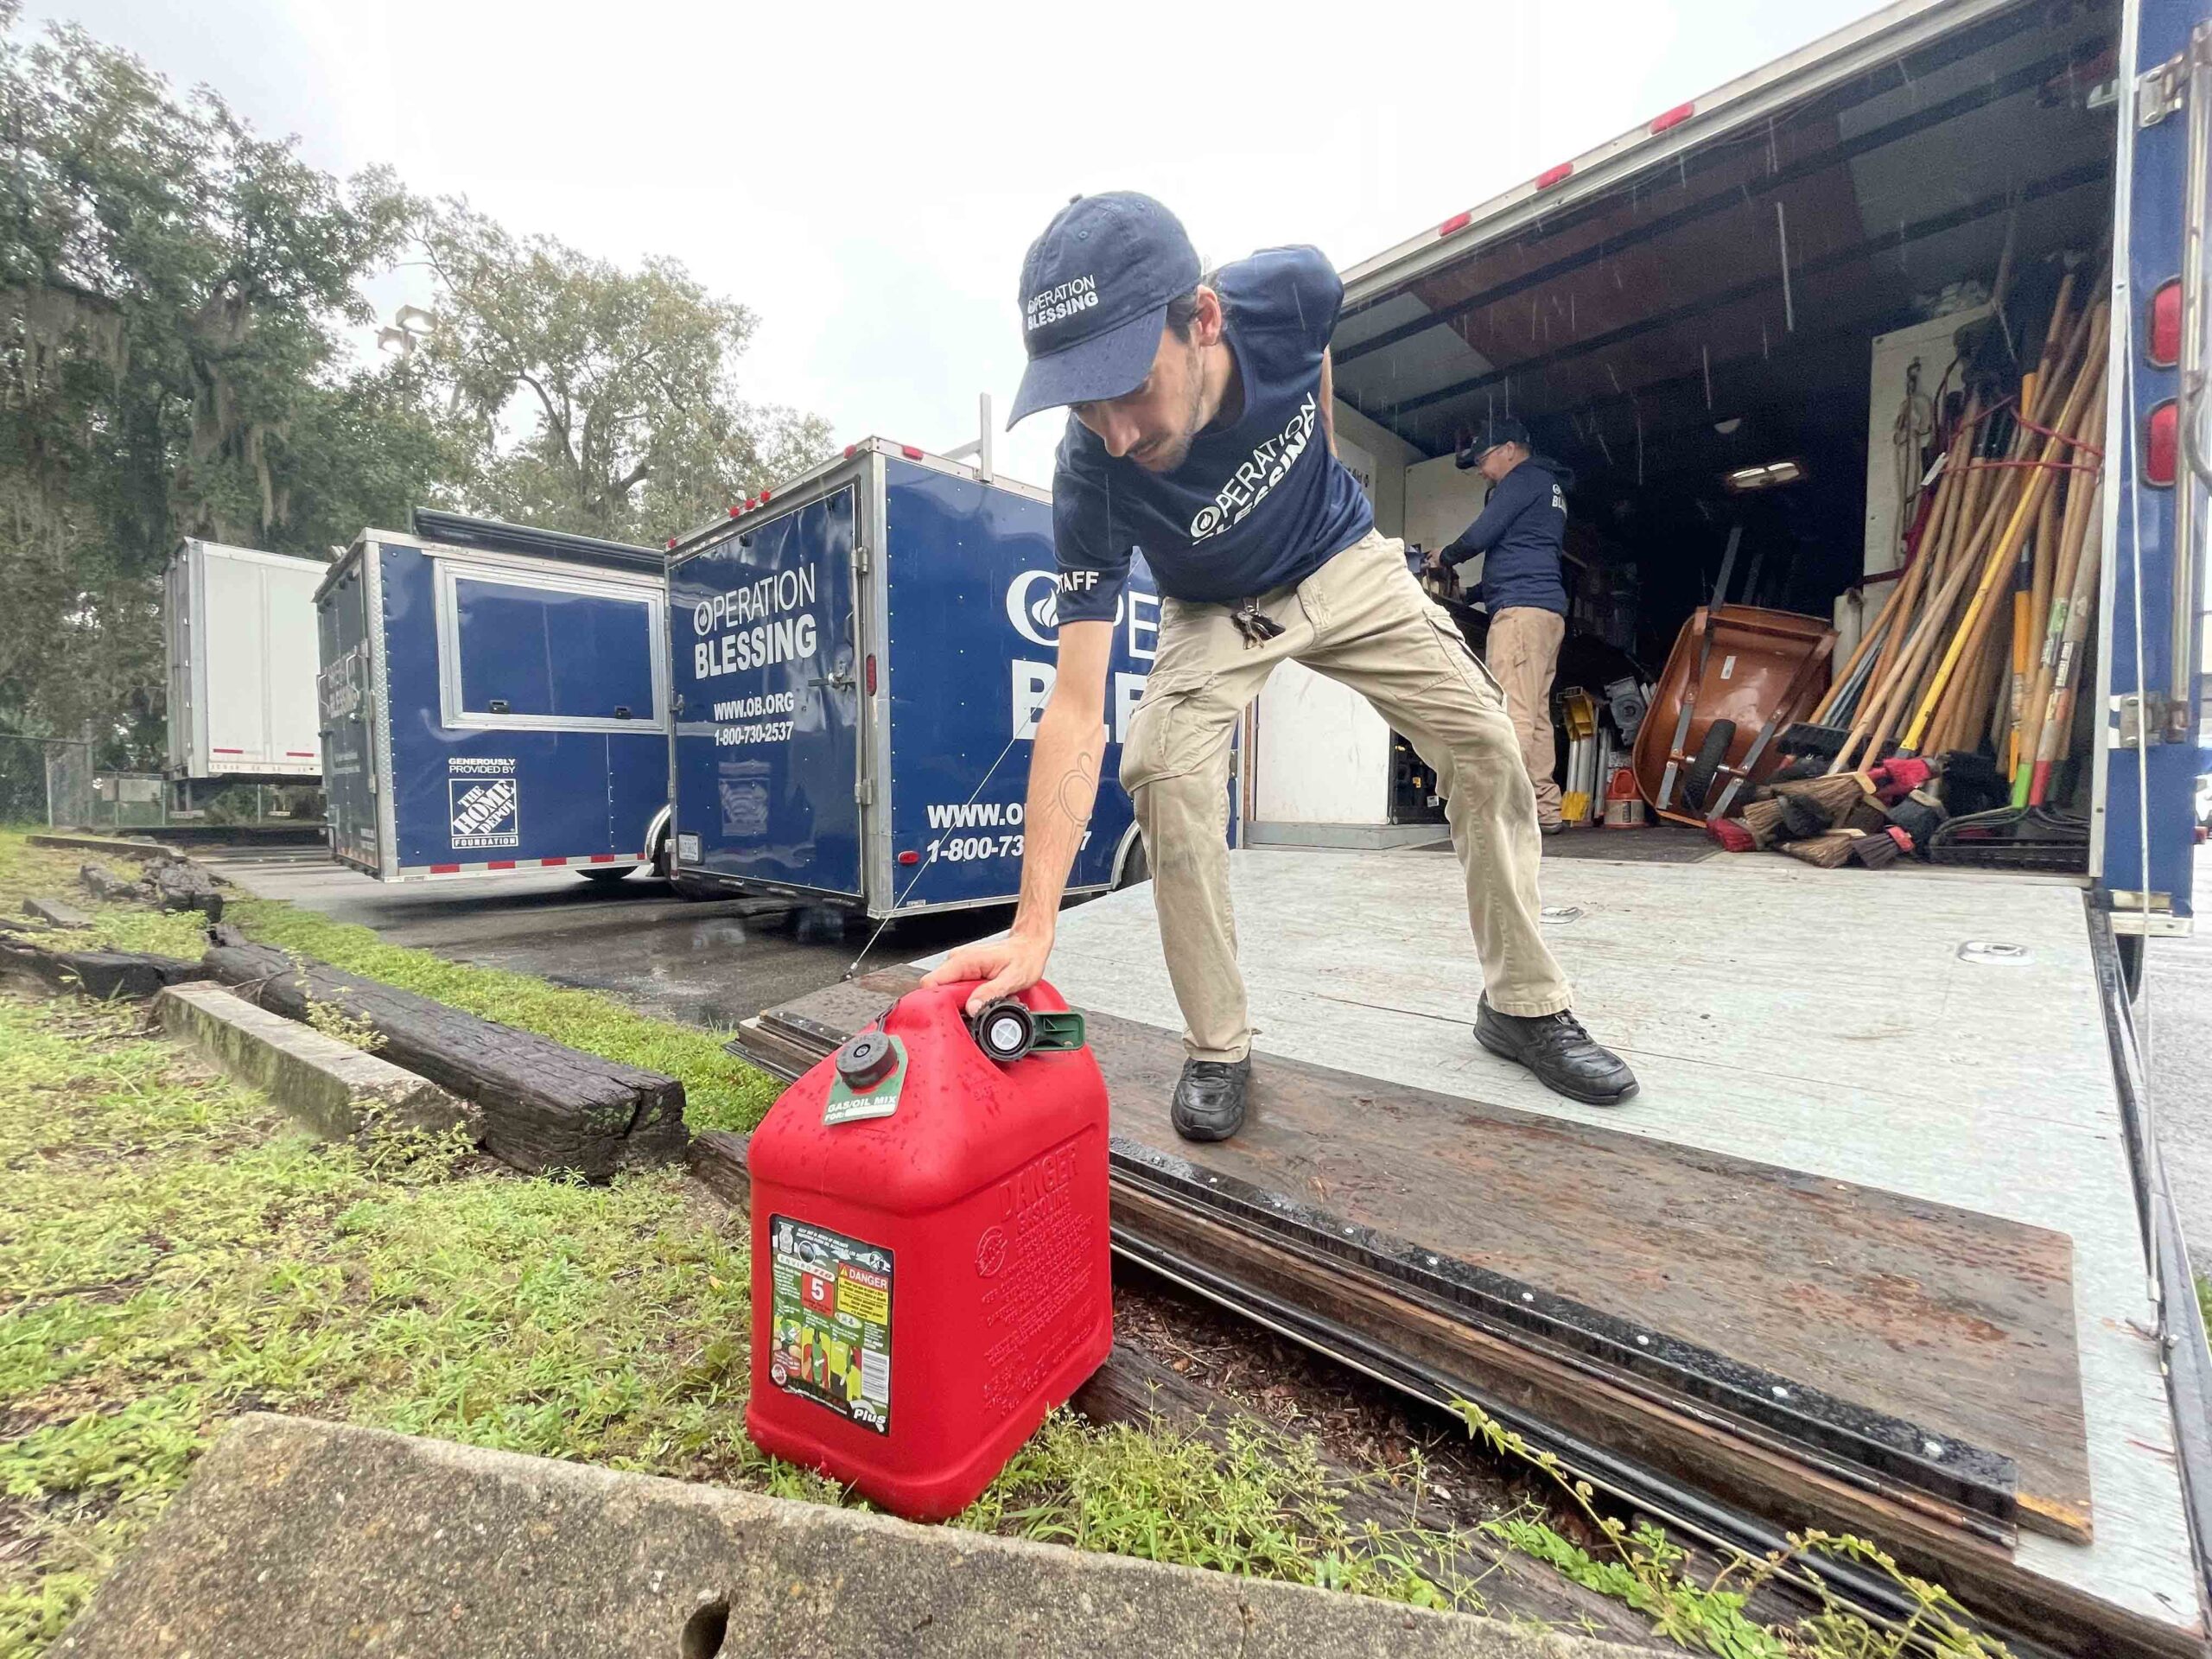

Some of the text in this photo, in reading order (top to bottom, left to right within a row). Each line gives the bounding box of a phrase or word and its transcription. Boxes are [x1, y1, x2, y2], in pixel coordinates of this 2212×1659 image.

[1027, 275, 1096, 314] OPERATION
[1028, 291, 1099, 331] BLESSING
[1190, 391, 1317, 537] OPERATION
[693, 563, 816, 636] OPERATION
[694, 613, 817, 680] BLESSING
[714, 691, 794, 721] WWW.OB.ORG
[715, 721, 794, 746] 1-800-730-2537
[449, 766, 516, 774] PROVIDED BY
[453, 779, 516, 835] HOME
[457, 785, 485, 808] THE
[477, 799, 515, 835] DEPOT
[927, 803, 1027, 829] WWW.O
[454, 837, 516, 847] FOUNDATION
[827, 1096, 897, 1113] GAS/OIL MIX
[811, 1277, 824, 1302] 5
[849, 1268, 887, 1289] DANGER
[853, 1408, 887, 1424] Plus
